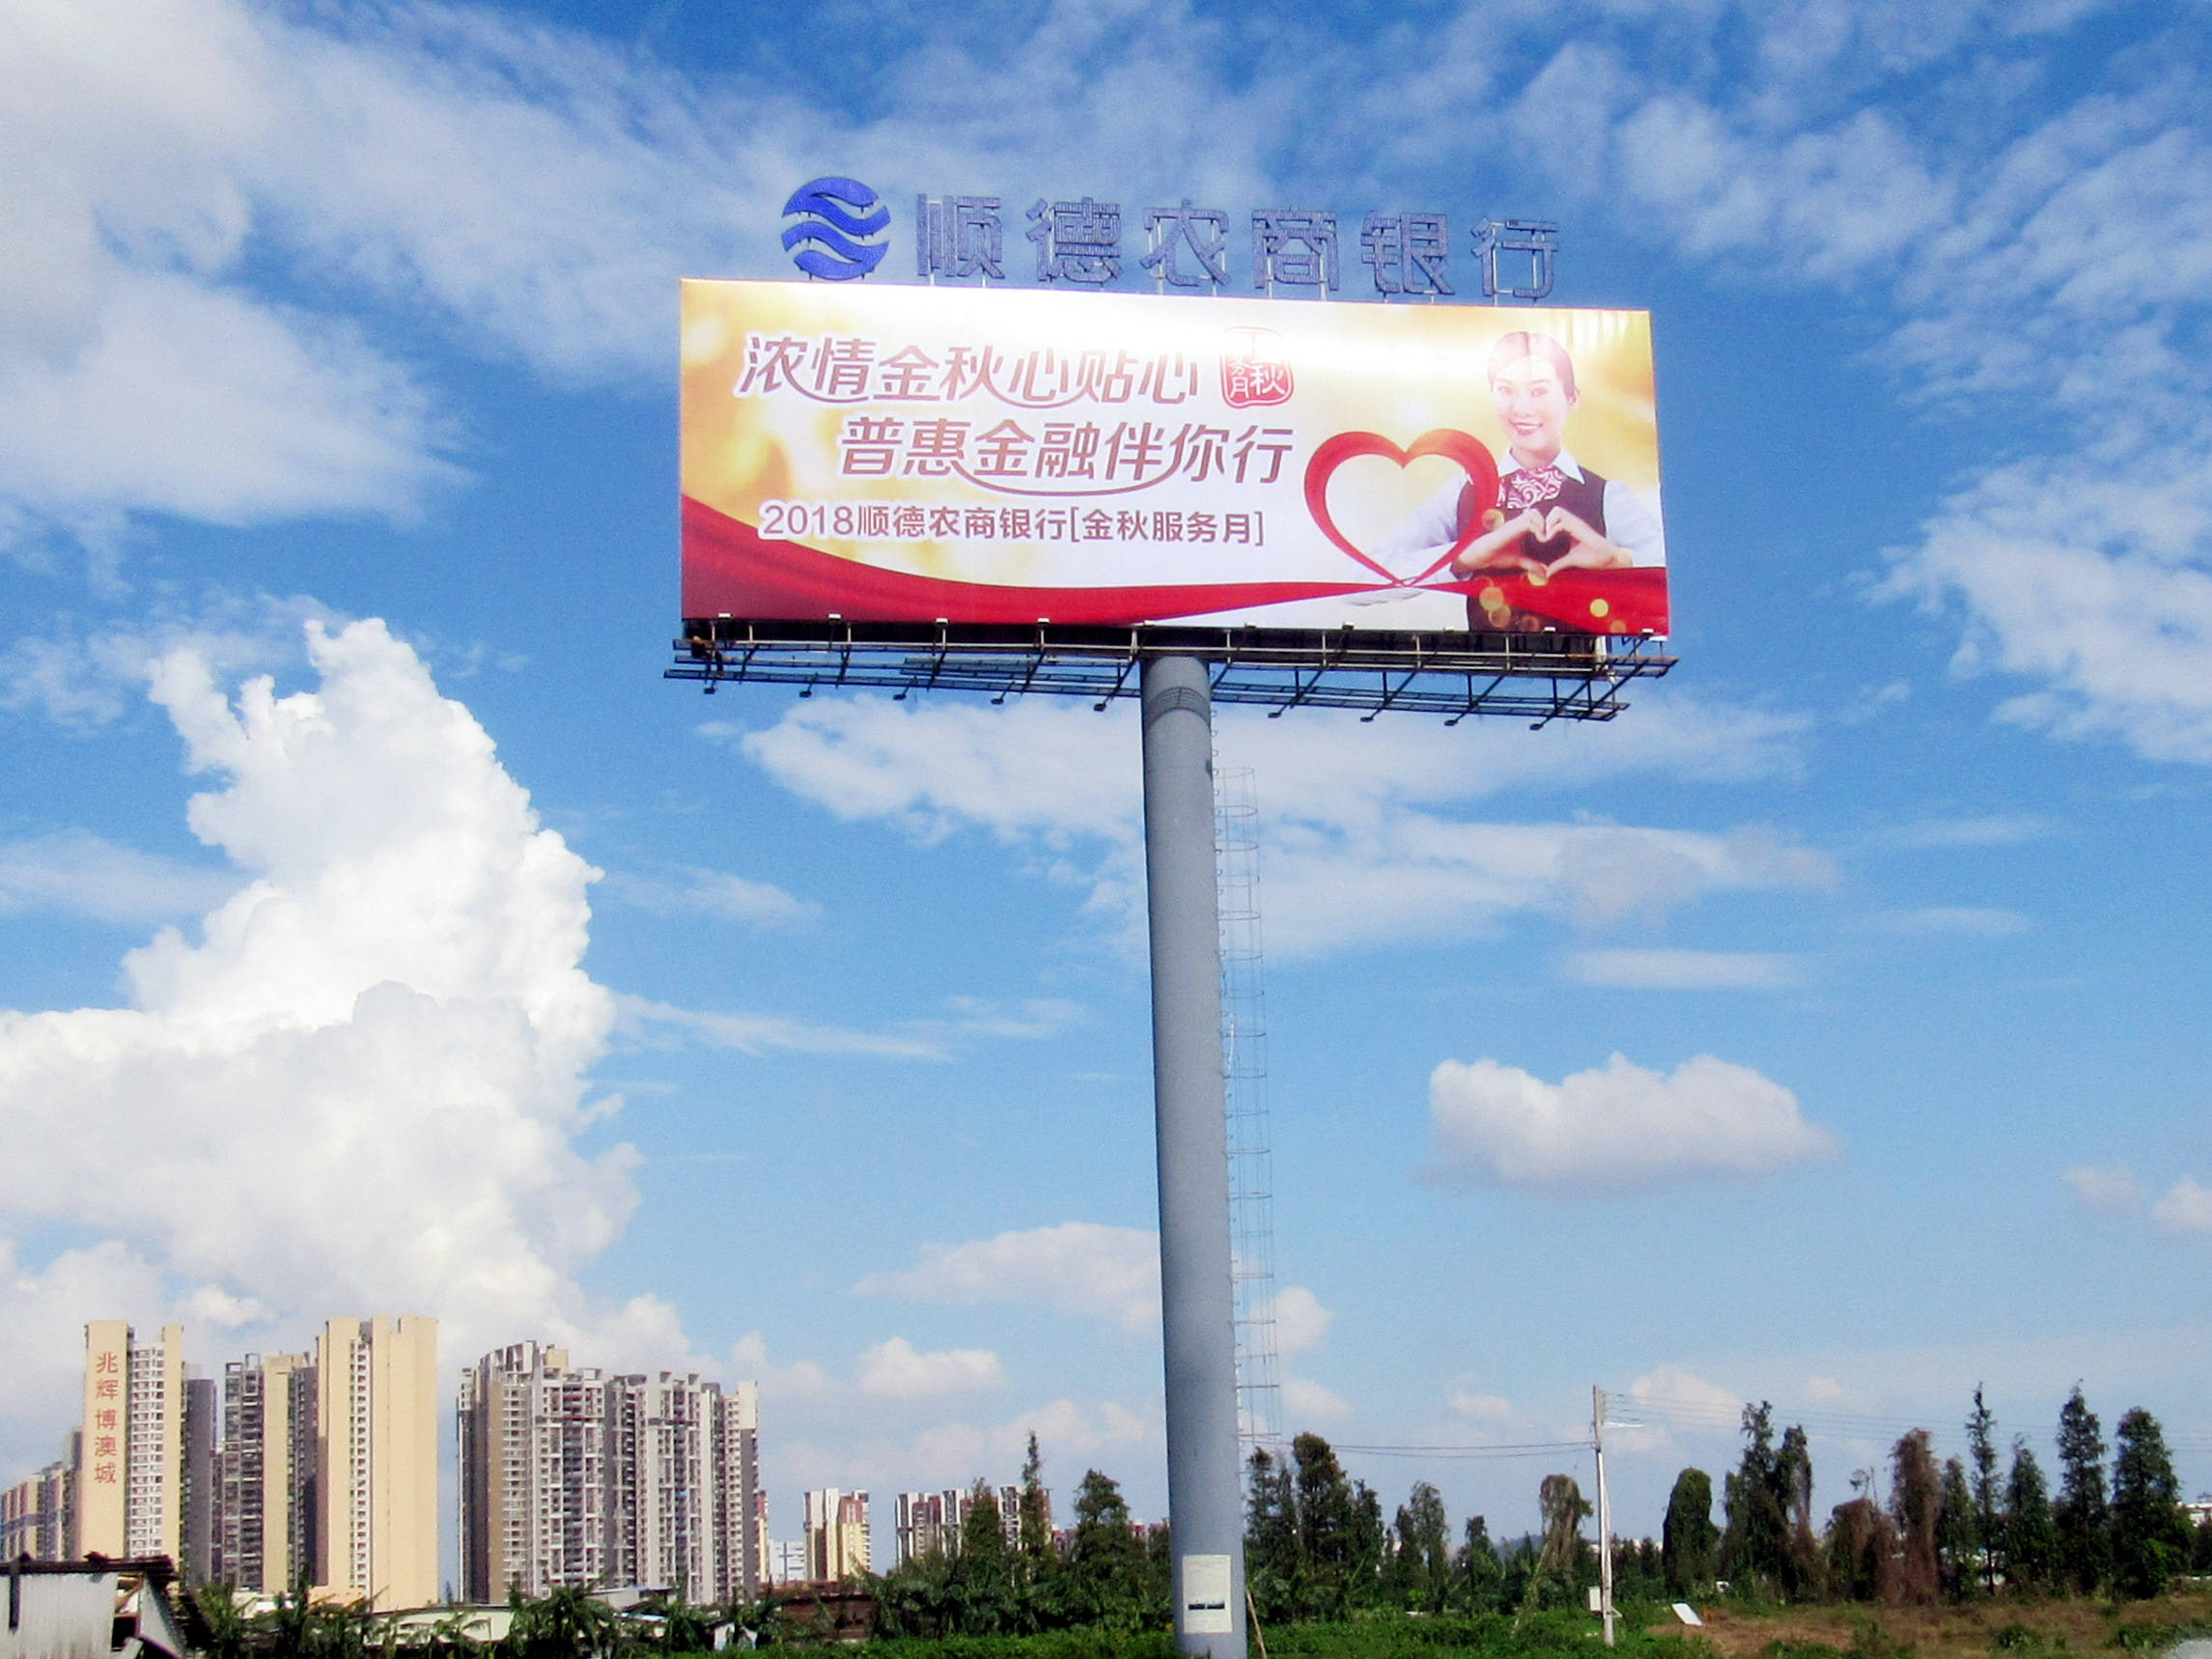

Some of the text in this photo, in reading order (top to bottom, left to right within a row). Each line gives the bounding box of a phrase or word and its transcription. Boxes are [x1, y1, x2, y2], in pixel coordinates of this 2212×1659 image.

[916, 194, 1558, 297] 顺德农商银行
[740, 336, 1198, 408] 浓情金秋心贴心
[841, 416, 1294, 496] 普惠金融伴你行
